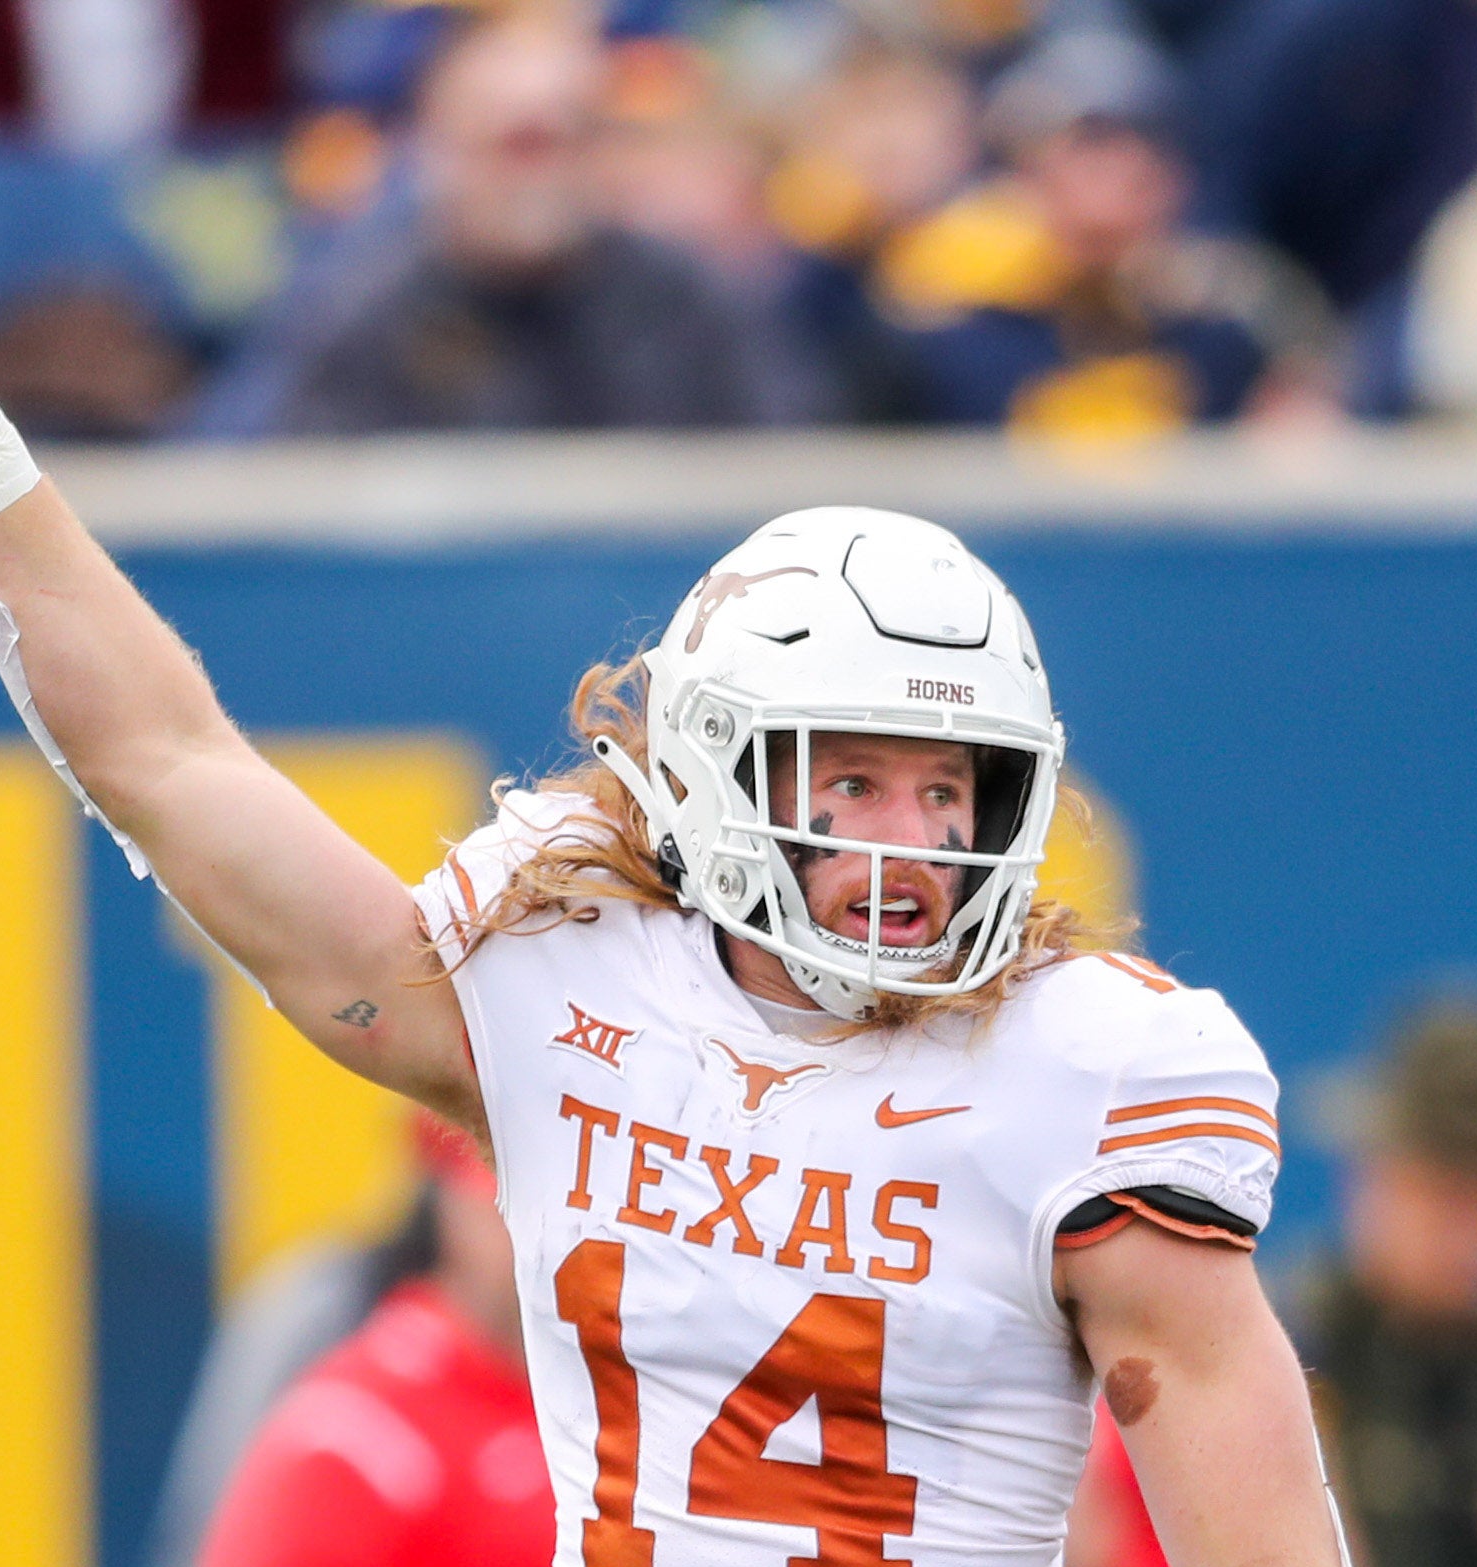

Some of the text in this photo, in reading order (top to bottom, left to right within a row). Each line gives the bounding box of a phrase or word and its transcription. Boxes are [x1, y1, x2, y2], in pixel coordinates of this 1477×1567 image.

[906, 678, 975, 706] HORNS
[552, 1000, 636, 1070] XII
[559, 1093, 939, 1286] TEXAS
